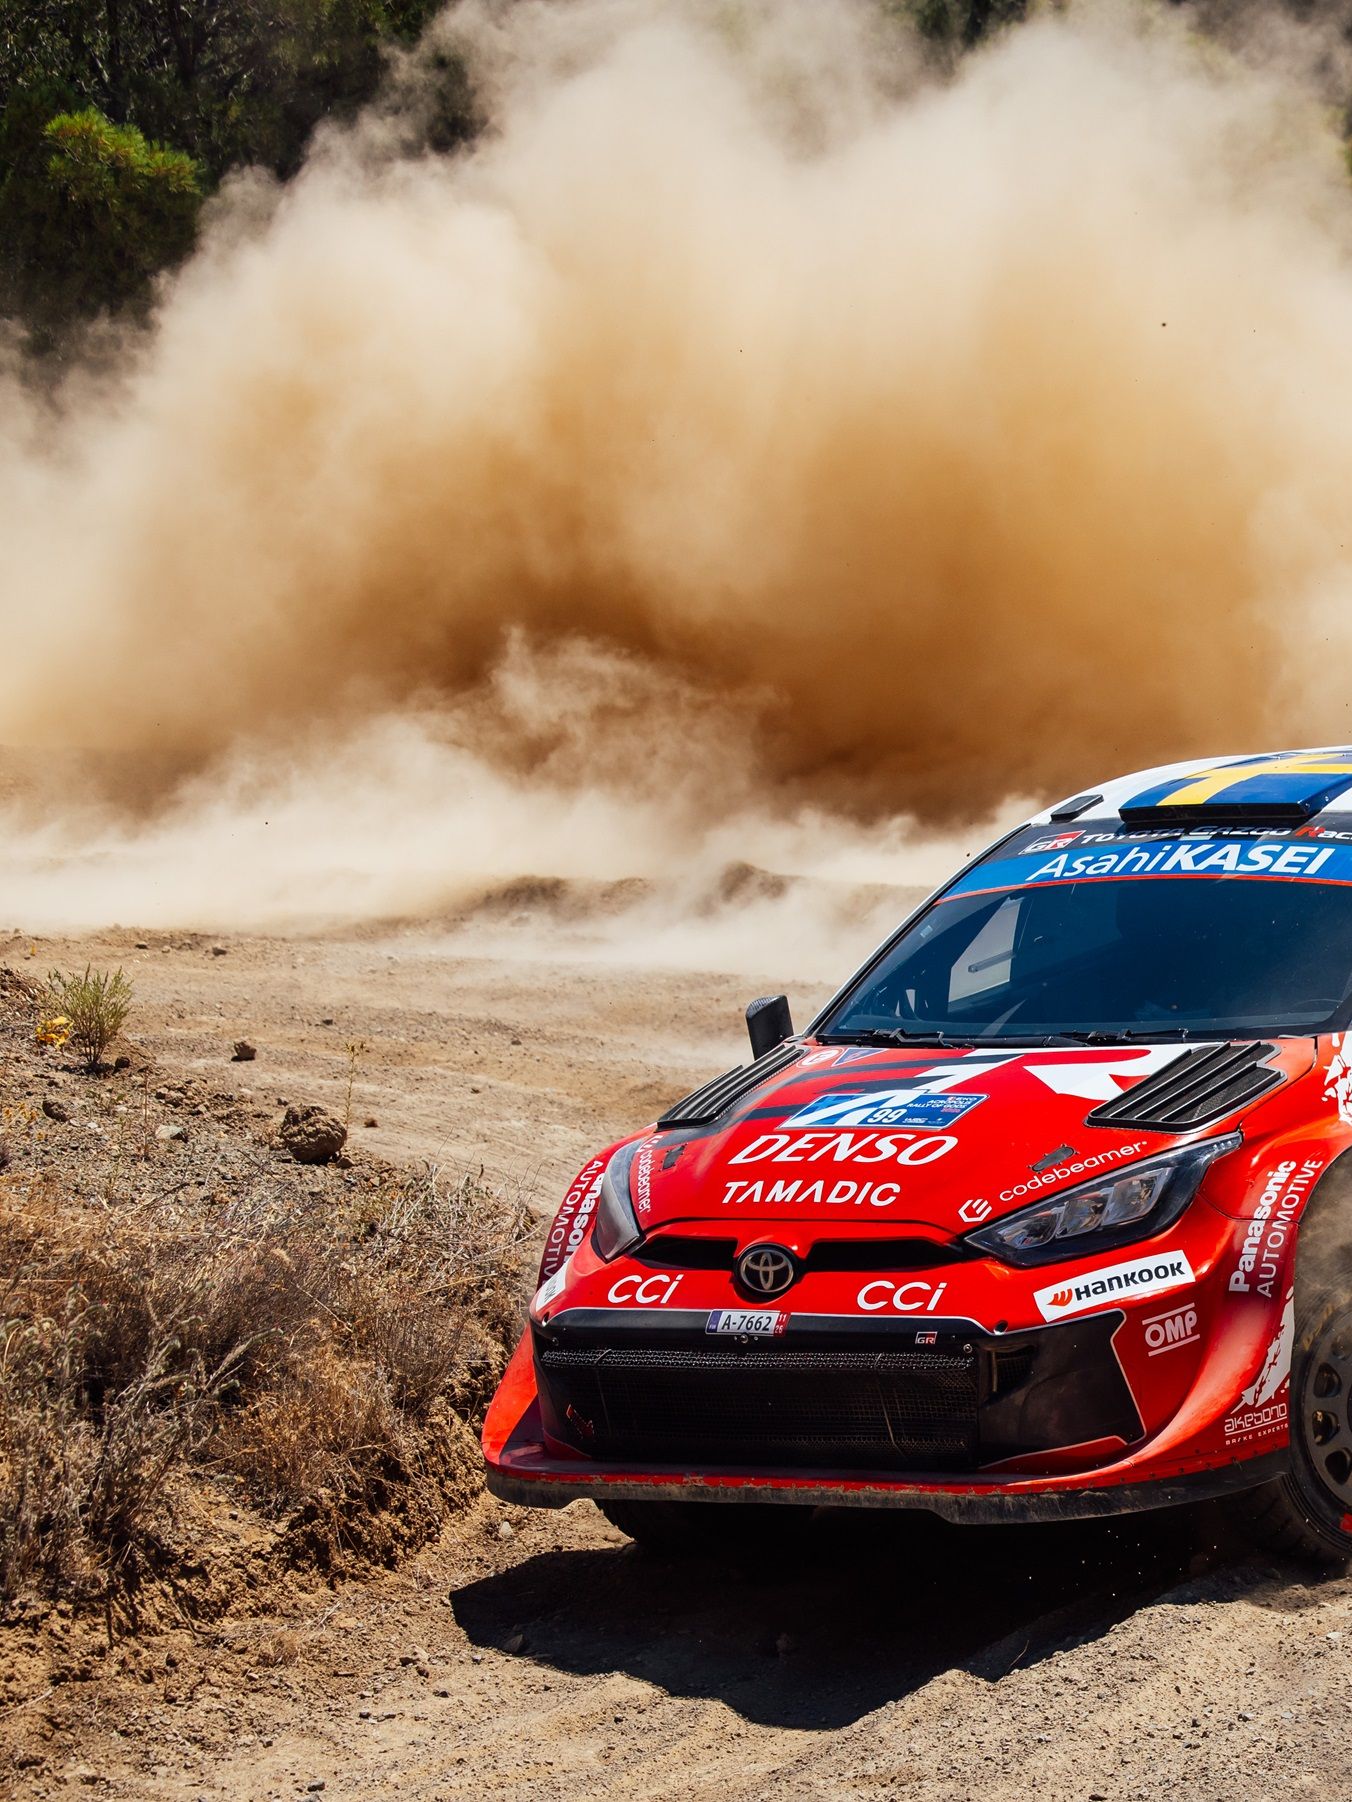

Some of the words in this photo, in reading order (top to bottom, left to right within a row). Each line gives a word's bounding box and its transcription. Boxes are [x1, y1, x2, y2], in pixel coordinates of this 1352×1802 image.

[1081, 828, 1185, 844] TOYOTA
[1187, 825, 1291, 837] GAZOO
[1025, 843, 1336, 882] AsahiKASEI
[867, 1108, 908, 1124] 99
[728, 1133, 959, 1166] DENSO
[999, 1141, 1144, 1202] codebeamer
[722, 1179, 901, 1207] TAMADIC
[542, 1160, 604, 1286] AUTOMOTIV
[1228, 1160, 1297, 1292] Panasonic
[1257, 1159, 1324, 1298] AUTOMOTIVE
[721, 1314, 772, 1331] A-7662
[1145, 1310, 1198, 1348] OMP
[917, 1335, 936, 1345] GR
[1224, 1403, 1287, 1433] akebono
[1225, 1434, 1253, 1445] BRAKE
[1258, 1423, 1289, 1437] EXPERTS
